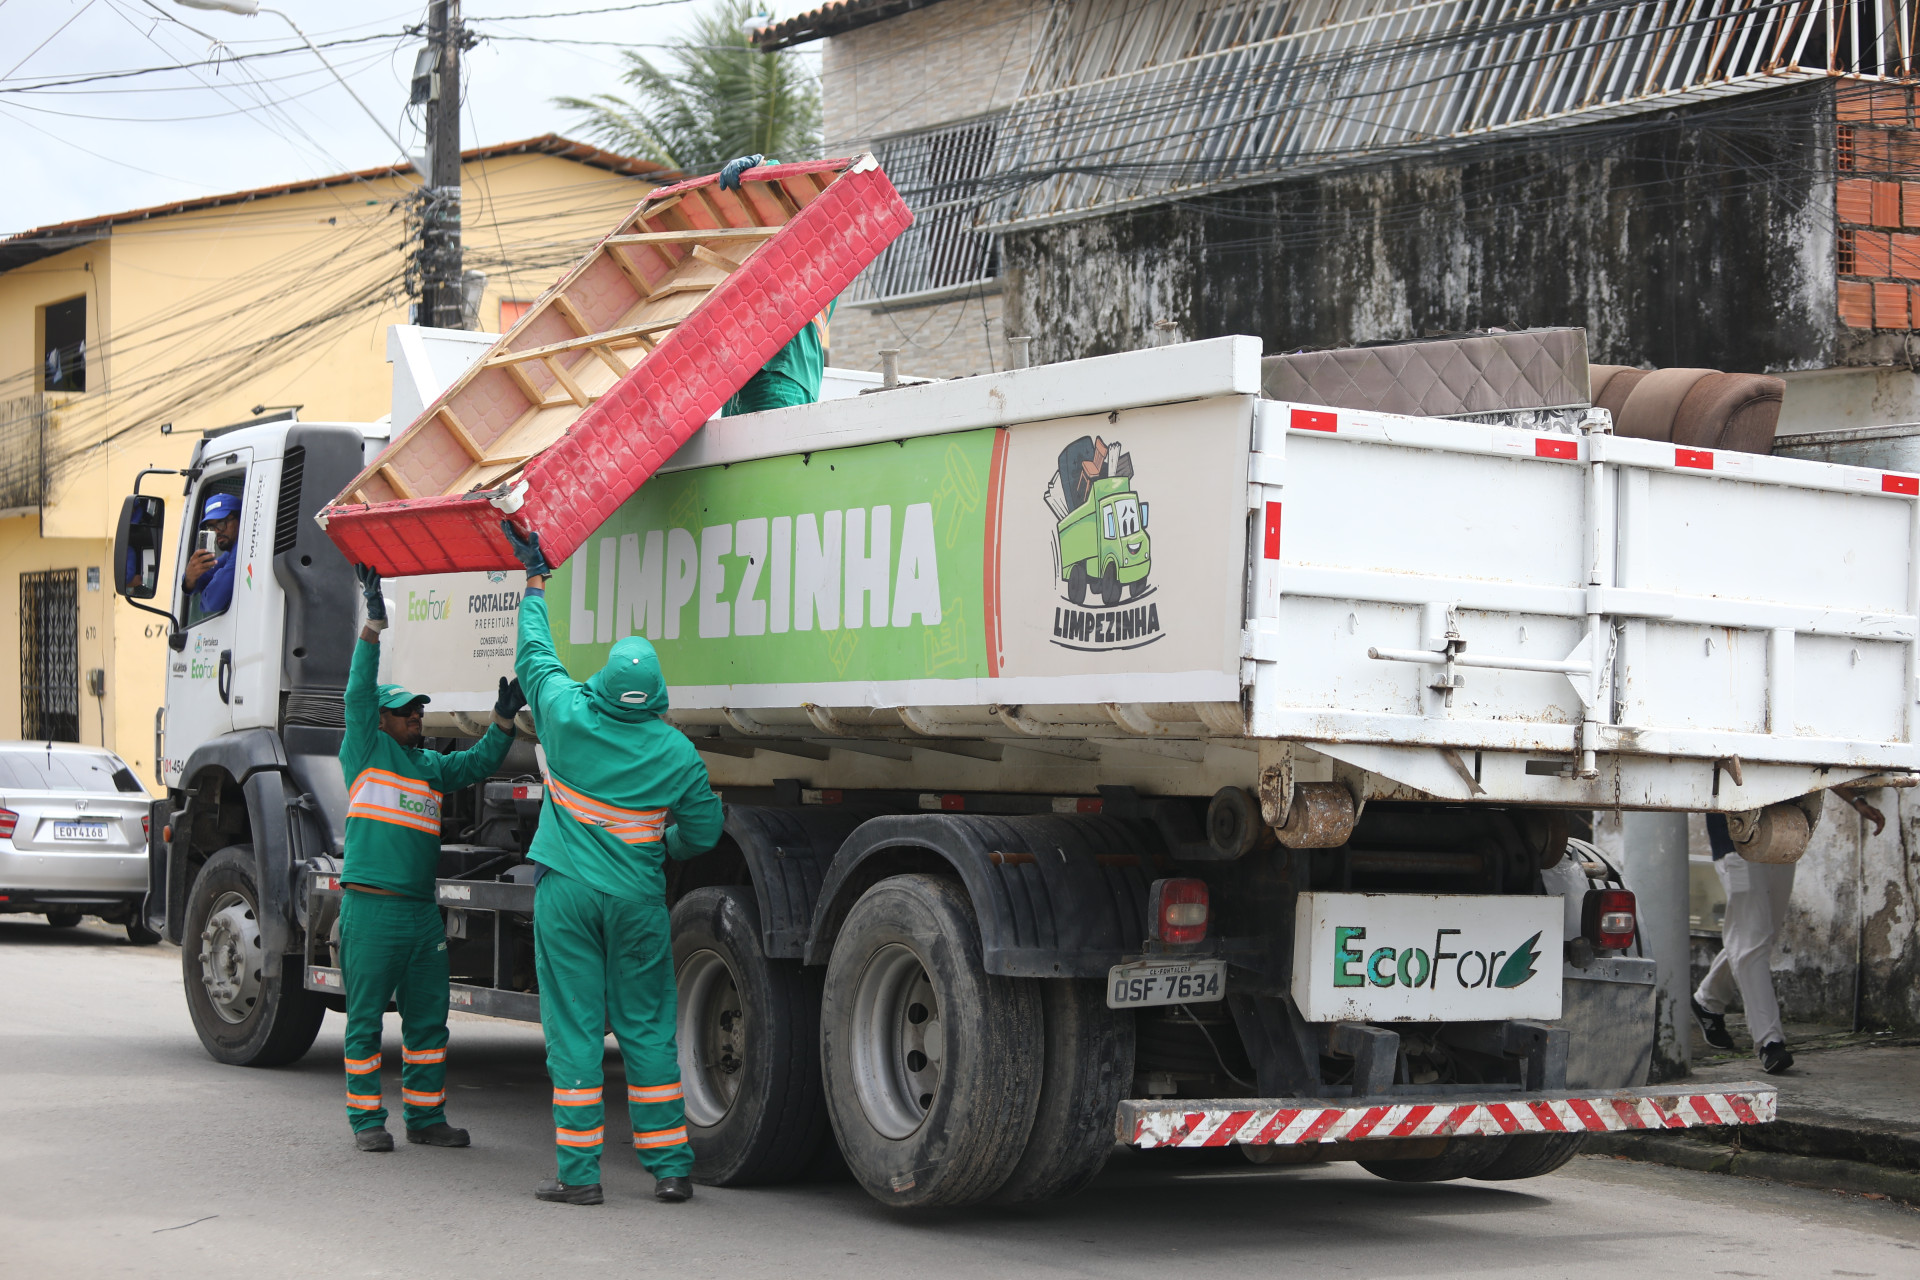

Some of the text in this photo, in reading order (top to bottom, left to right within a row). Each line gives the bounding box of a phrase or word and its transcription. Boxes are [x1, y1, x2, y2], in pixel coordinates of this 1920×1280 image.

[570, 502, 942, 644] LIMPEZINHA
[408, 590, 445, 621] EcoFor
[469, 592, 521, 613] FORTALEZA
[86, 626, 97, 640] 670
[475, 617, 514, 629] PREFEITURA
[1054, 603, 1160, 642] LIMPEZINHA
[480, 634, 508, 646] CONSERVAÇÃO
[476, 648, 495, 659] SERVIÇOS
[495, 647, 514, 657] PÚBLICOS
[1333, 926, 1506, 989] EcoFor
